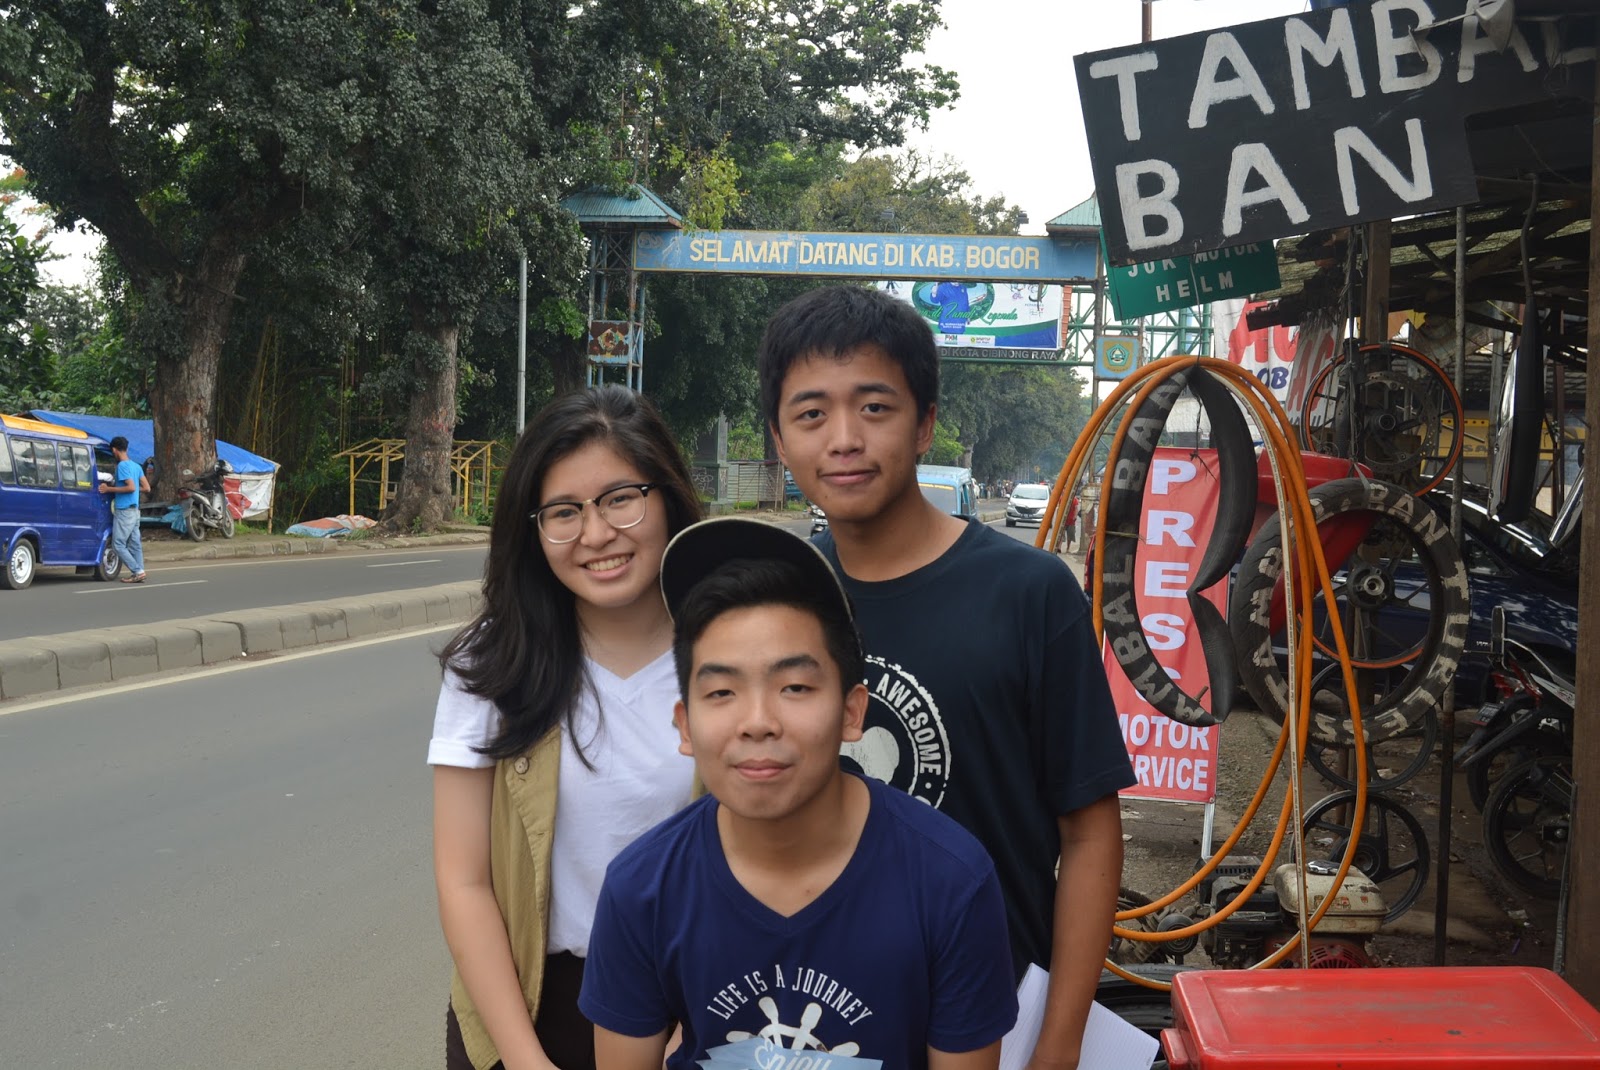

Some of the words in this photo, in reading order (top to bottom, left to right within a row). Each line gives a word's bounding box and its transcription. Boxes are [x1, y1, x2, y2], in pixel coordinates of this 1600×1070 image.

[1115, 118, 1433, 251] BAN
[690, 239, 794, 264] SELAMAT
[800, 241, 877, 266] DATANG
[884, 243, 903, 267] DI
[911, 244, 960, 268] KAB.
[967, 246, 1040, 270] BOGOR
[1156, 271, 1233, 302] HELM
[952, 348, 979, 358] KOTA
[981, 349, 1029, 359] CIBINONG
[1032, 350, 1057, 360] RAYA
[875, 673, 942, 776] AWESOME
[707, 983, 749, 1021] LIFE
[744, 971, 769, 996] IS
[775, 964, 786, 989] A
[792, 967, 873, 1026] JOURNEY
